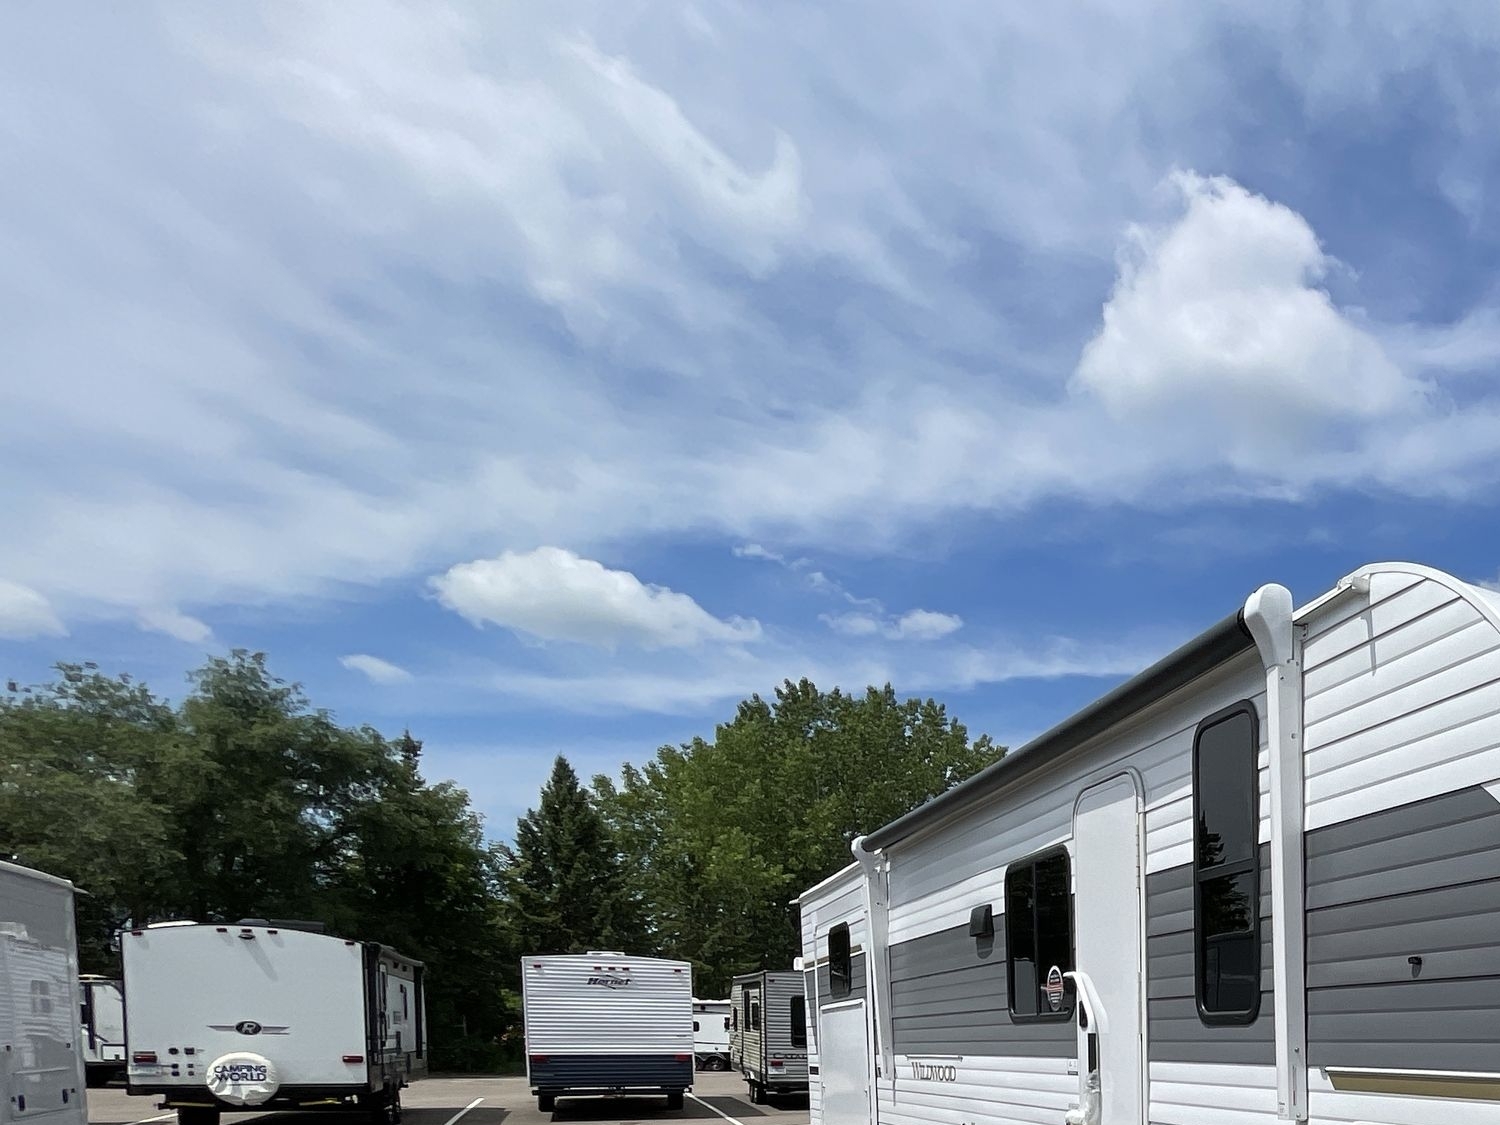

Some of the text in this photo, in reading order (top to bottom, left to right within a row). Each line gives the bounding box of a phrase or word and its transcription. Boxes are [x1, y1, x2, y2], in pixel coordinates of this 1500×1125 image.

[587, 977, 632, 986] Hornet
[214, 1064, 267, 1074] CAMPING
[911, 1061, 957, 1081] WILDWOOD
[215, 1072, 267, 1082] WORLD
